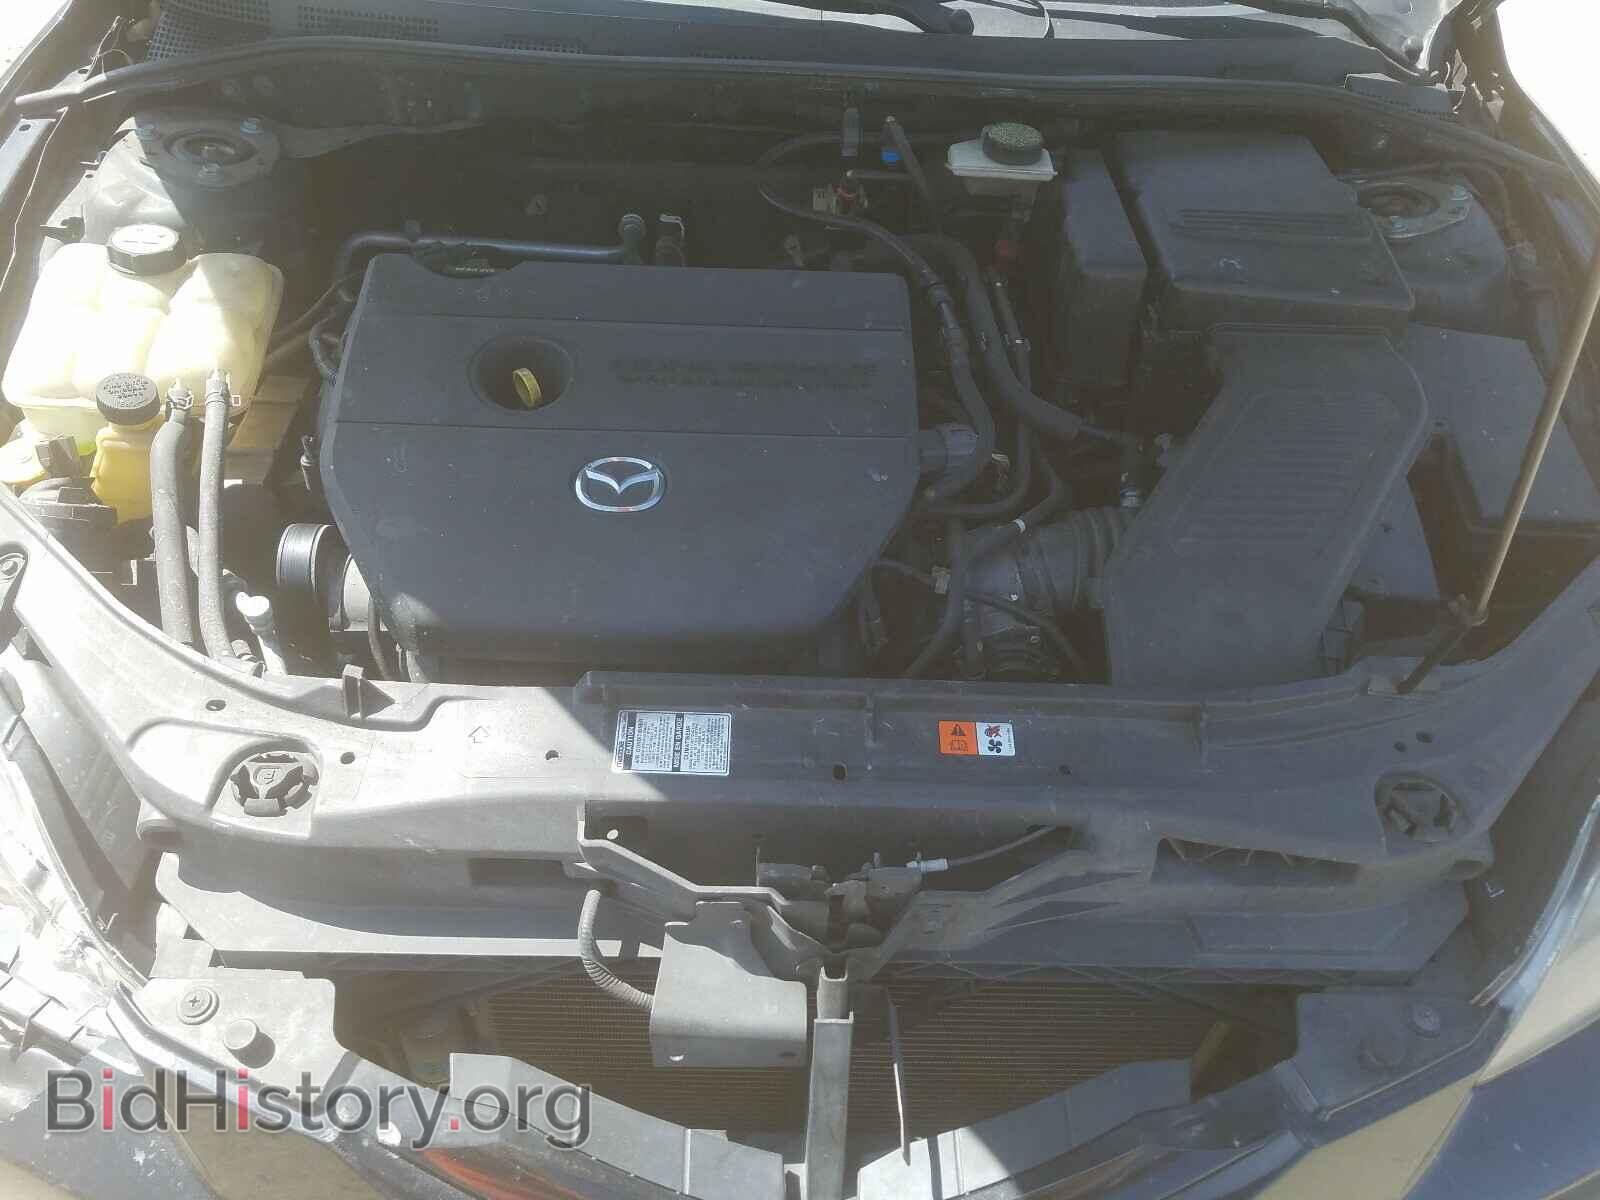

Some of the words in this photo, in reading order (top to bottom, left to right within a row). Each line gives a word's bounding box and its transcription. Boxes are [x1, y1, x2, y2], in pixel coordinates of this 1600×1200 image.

[675, 717, 683, 740] GARDE
[626, 726, 635, 755] CAUTION
[674, 741, 681, 750] EN
[673, 752, 681, 768] MISE
